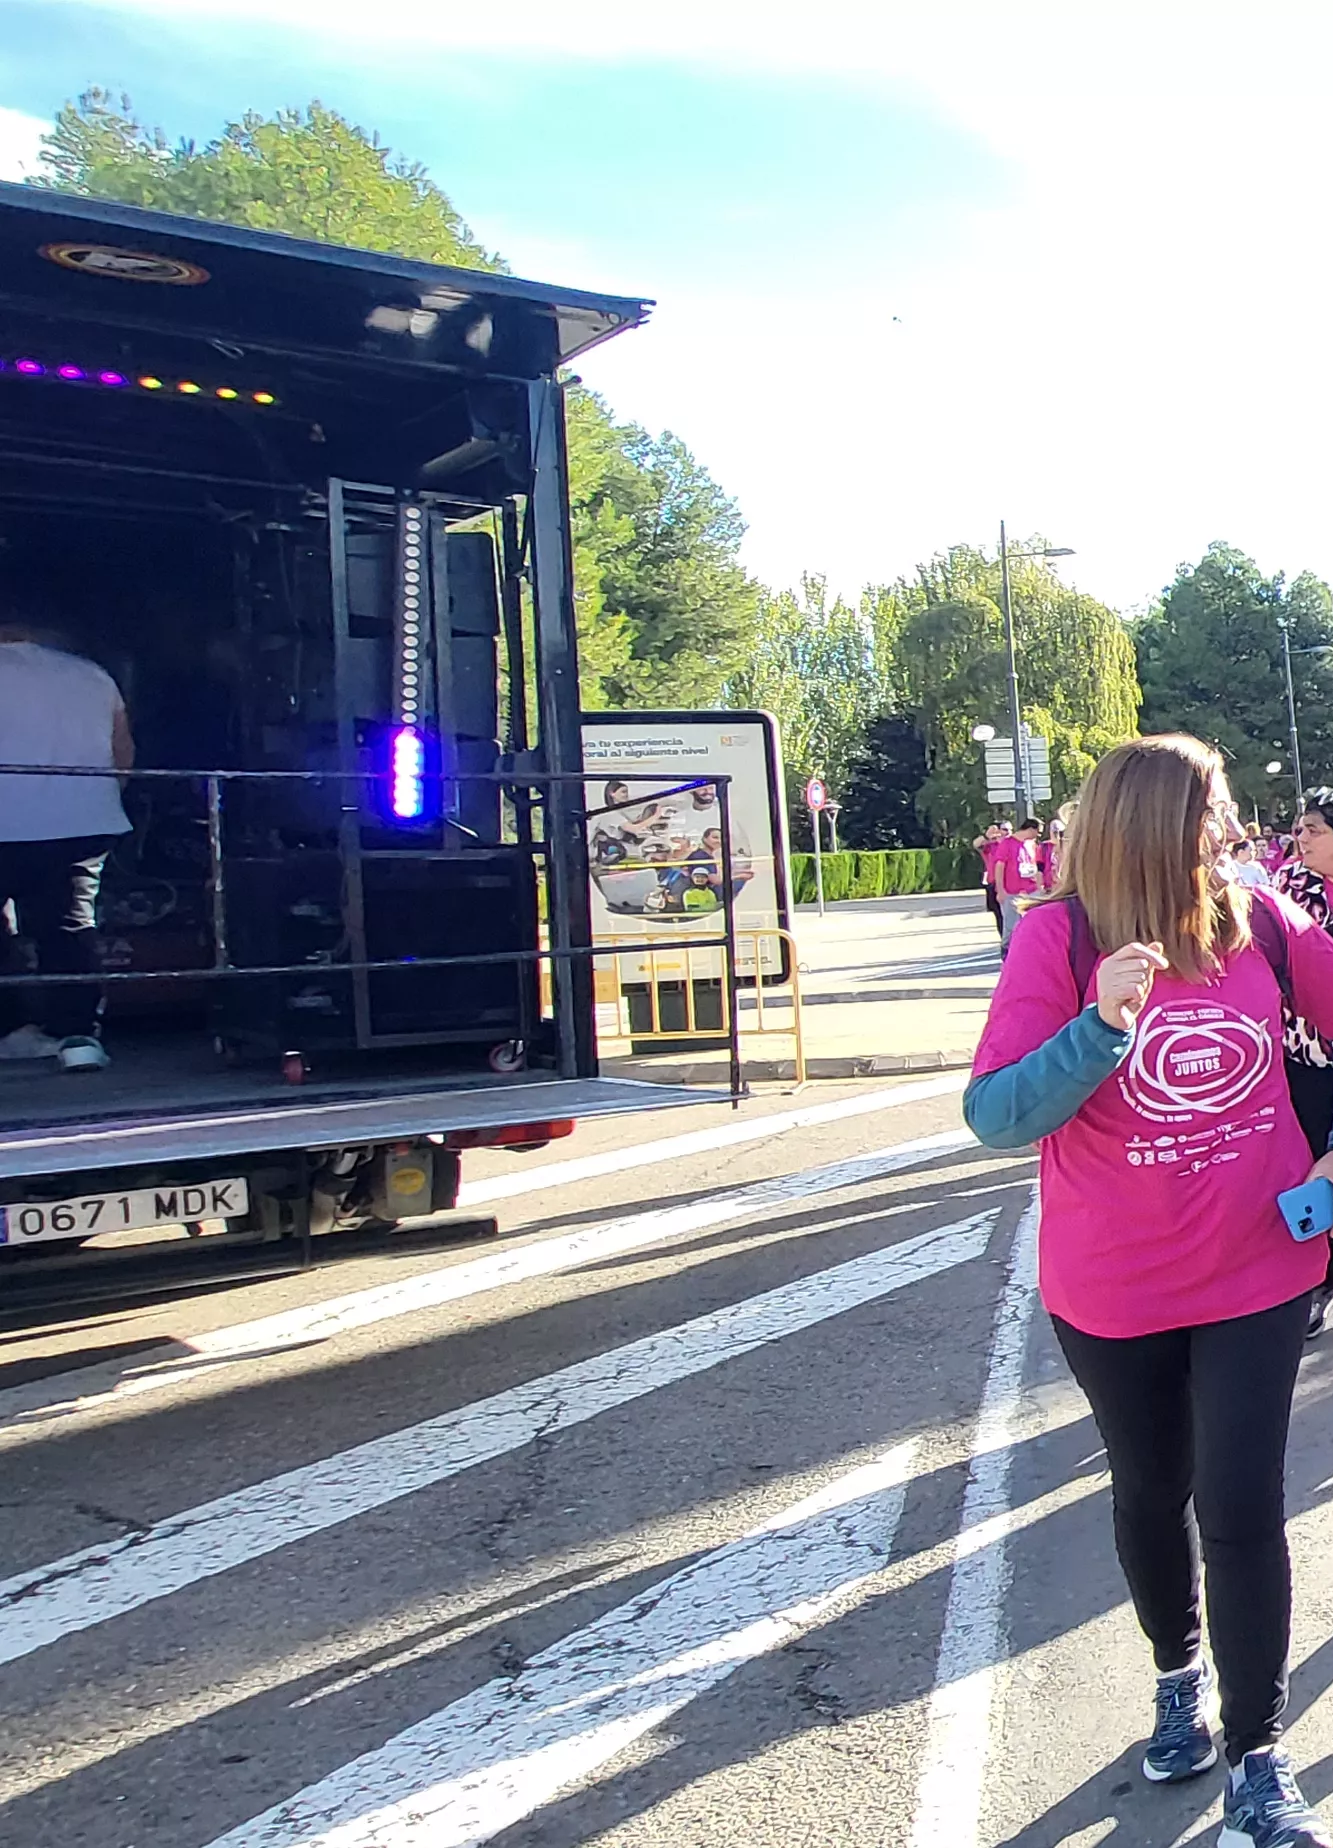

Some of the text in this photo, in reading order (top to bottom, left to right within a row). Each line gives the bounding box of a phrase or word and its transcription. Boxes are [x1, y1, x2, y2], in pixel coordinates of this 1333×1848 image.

[614, 738, 684, 749] experiencia
[583, 746, 709, 758] oral al siguiente nivel
[19, 1184, 235, 1237] 0671 MDK
